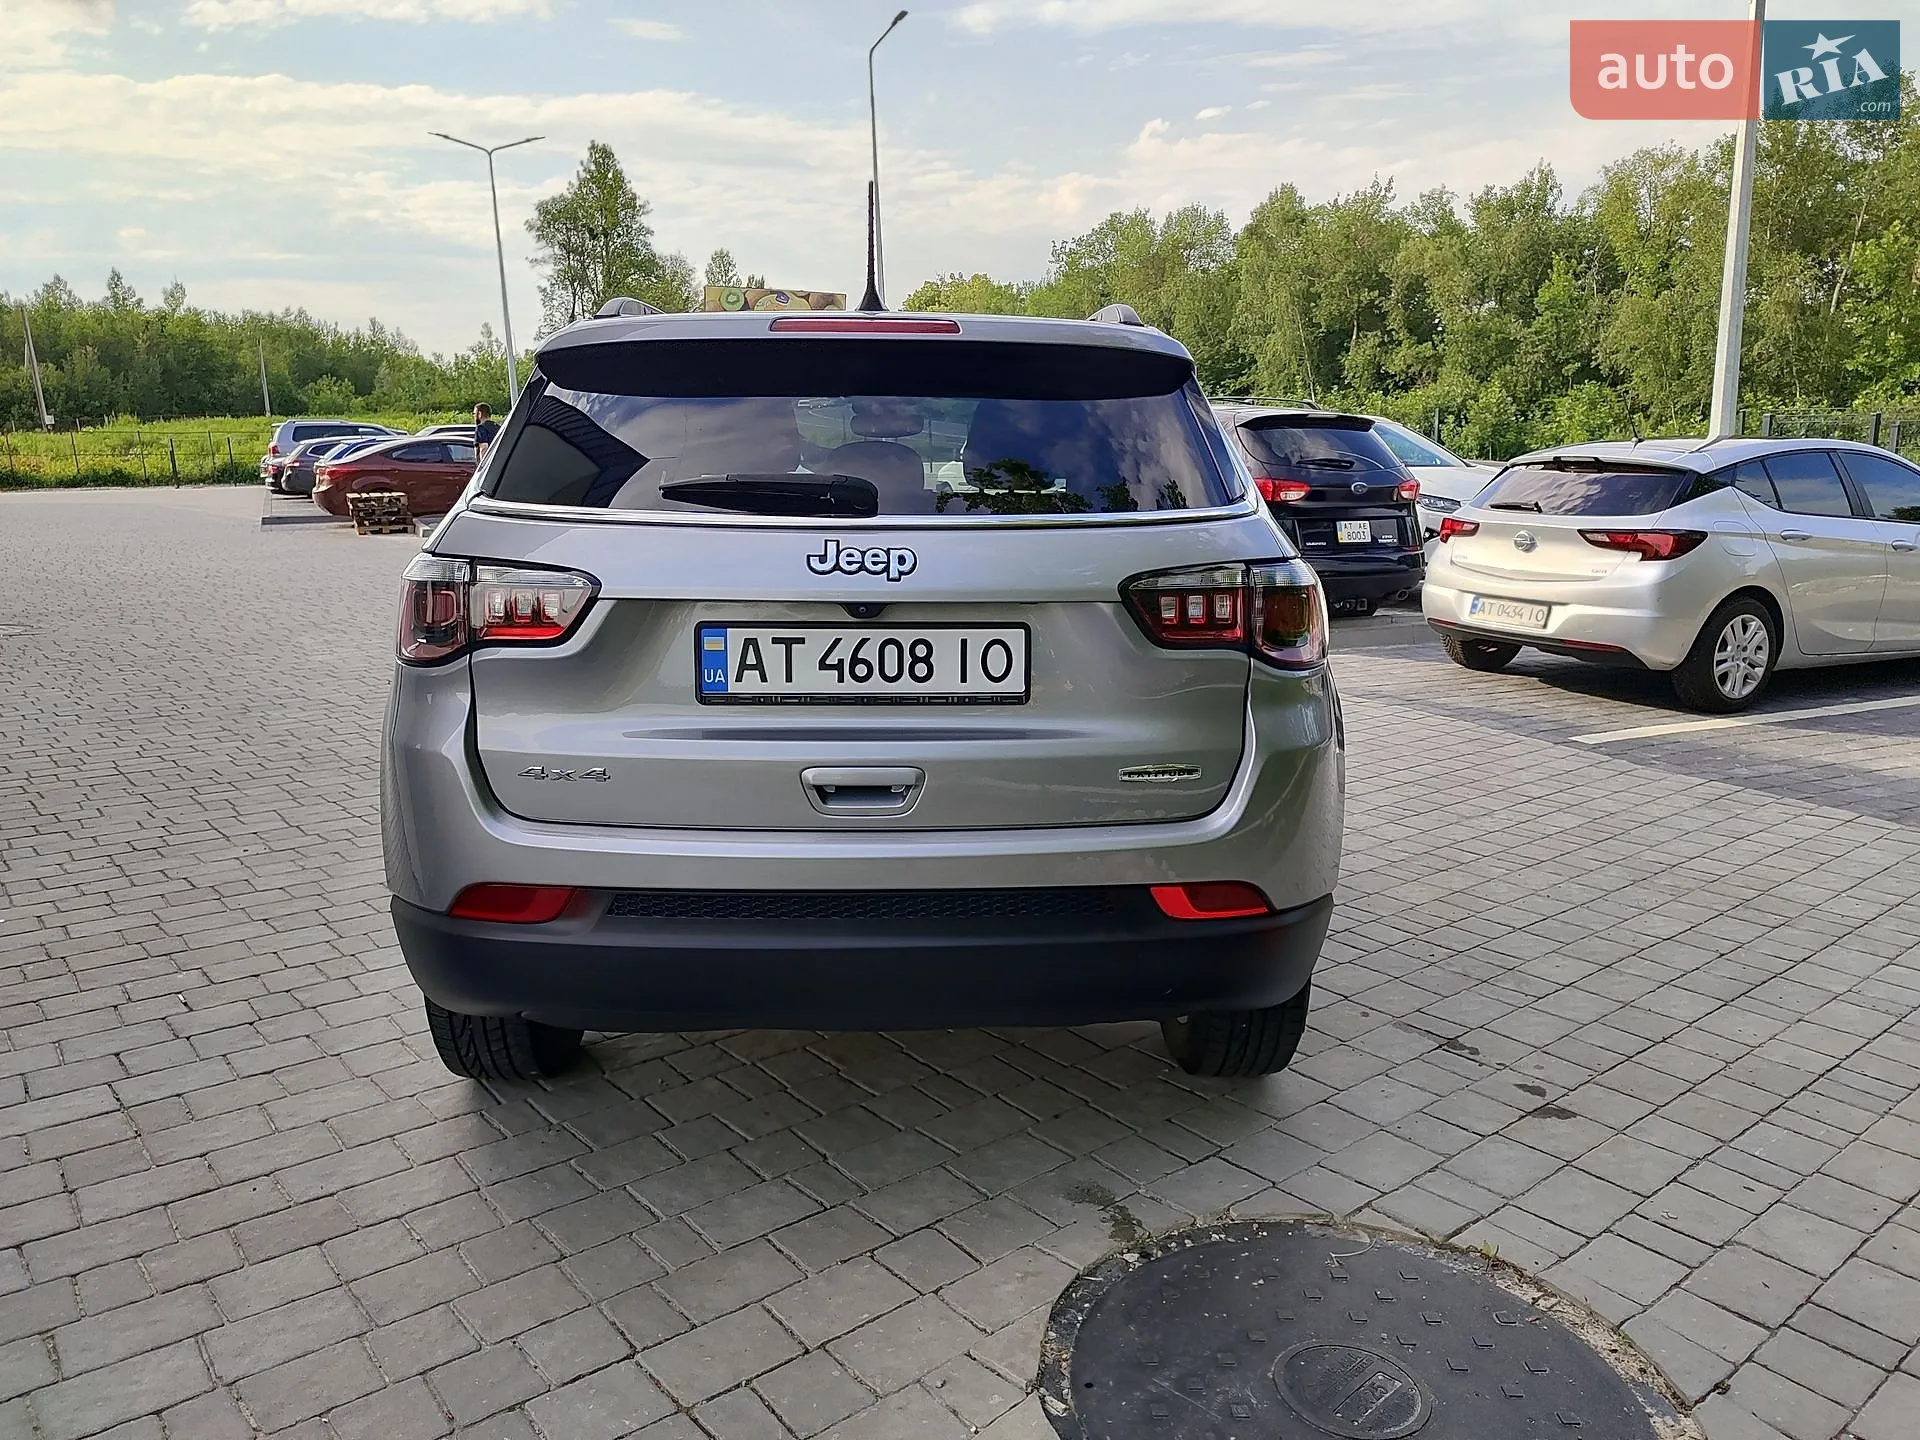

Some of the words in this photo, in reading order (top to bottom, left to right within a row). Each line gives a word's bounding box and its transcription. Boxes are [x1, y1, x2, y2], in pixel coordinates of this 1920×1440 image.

[1347, 531, 1367, 540] 8003
[806, 539, 918, 582] Jeep
[1478, 601, 1495, 616] AT
[1497, 603, 1524, 619] 0434
[1528, 607, 1546, 622] IO
[734, 636, 806, 684] AT
[817, 636, 935, 684] 4608
[959, 636, 1014, 685] IO
[704, 668, 726, 683] UA
[517, 765, 612, 783] 4x4
